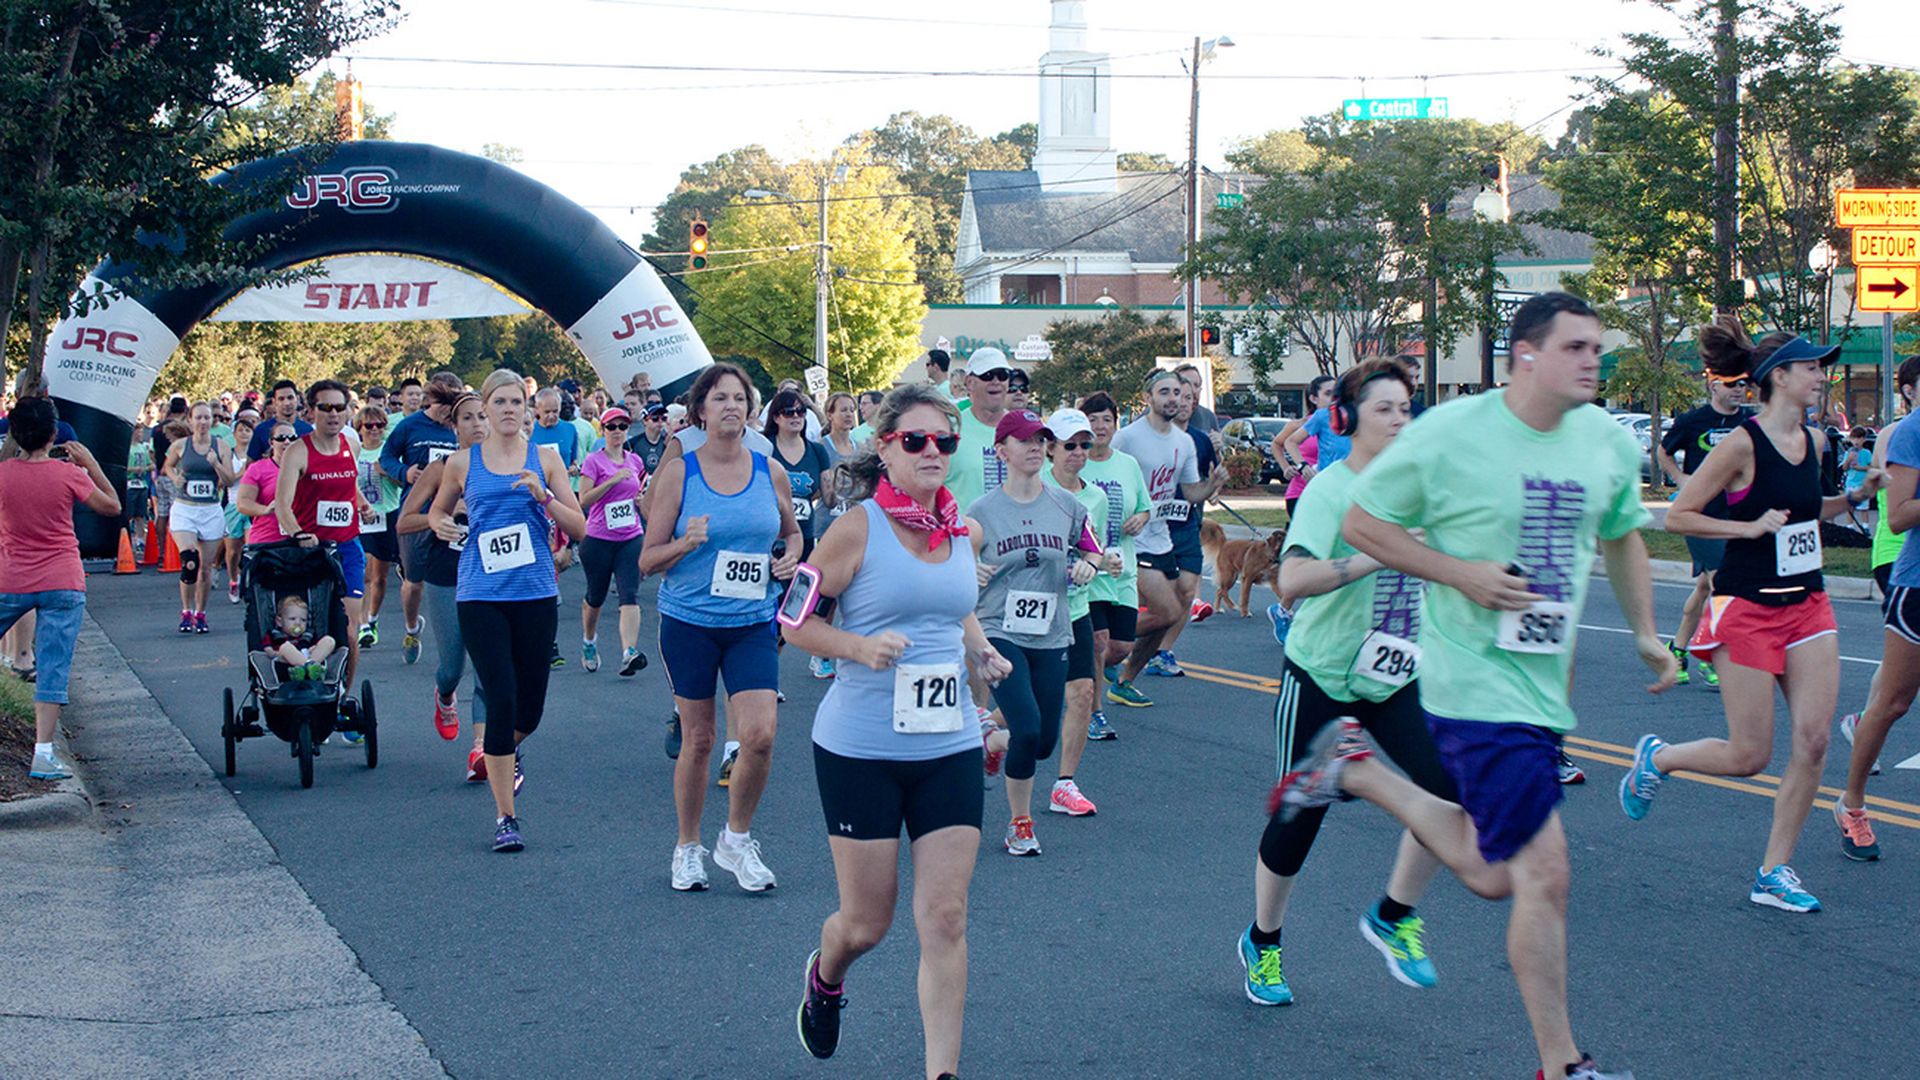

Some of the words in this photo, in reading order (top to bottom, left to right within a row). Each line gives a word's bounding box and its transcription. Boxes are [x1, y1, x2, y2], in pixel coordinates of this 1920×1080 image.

[1368, 100, 1418, 118] Central
[286, 172, 391, 209] JRC
[364, 184, 393, 194] JONES
[393, 184, 422, 194] RACING
[423, 184, 462, 193] COMPANY
[1842, 200, 1918, 218] MORNINGSIDE
[1859, 235, 1917, 257] DETOUR
[303, 280, 438, 310] START
[612, 304, 679, 341] JRC
[62, 327, 139, 358] JRC
[620, 340, 655, 359] JONES
[656, 332, 690, 348] RACING
[637, 345, 684, 366] COMPANY
[57, 359, 94, 371] JONES
[95, 362, 137, 378] RACING
[69, 370, 122, 388] COMPANY
[810, 379, 827, 392] 35
[311, 470, 356, 481] RUNALOT
[324, 507, 350, 522] 458
[610, 504, 633, 520] 332
[489, 533, 521, 557] 457
[996, 533, 1041, 557] CAROLINA
[1041, 532, 1064, 552] BAND
[1788, 530, 1817, 557] 253
[725, 560, 762, 584] 395
[1015, 599, 1048, 619] 321
[1372, 645, 1416, 679] 294
[913, 676, 957, 709] 120
